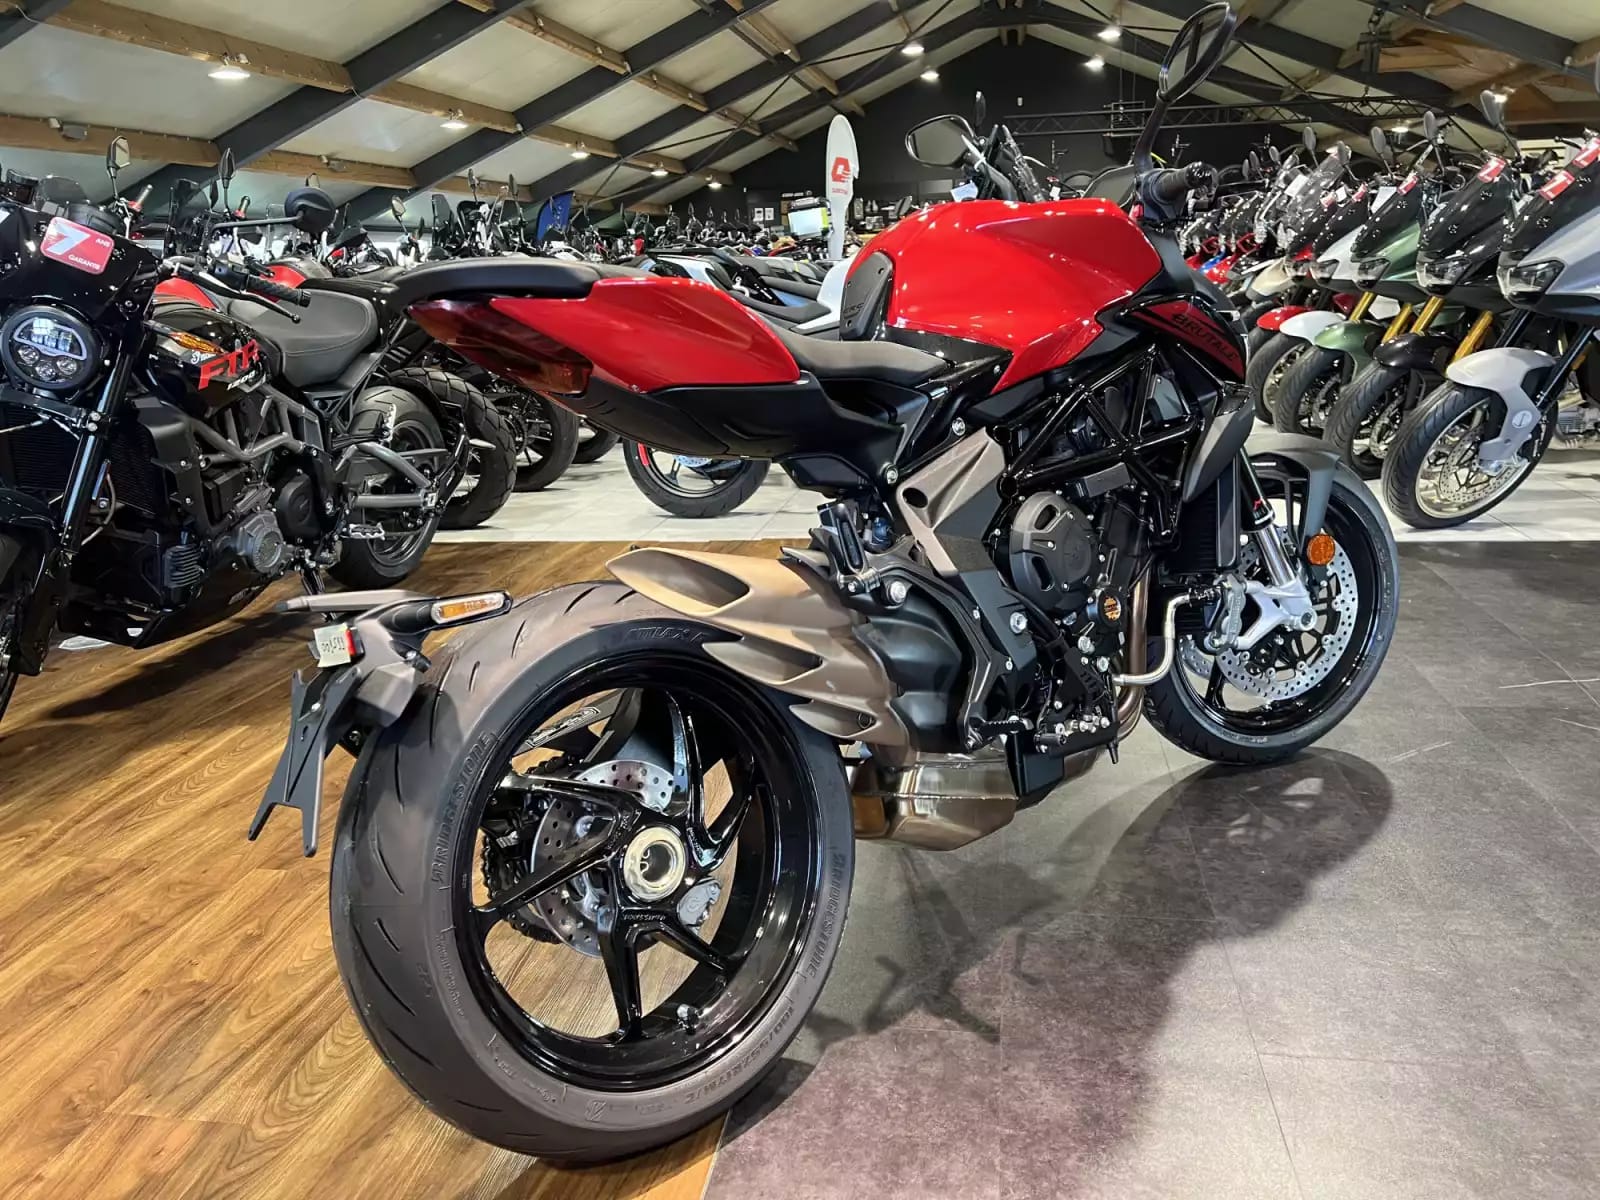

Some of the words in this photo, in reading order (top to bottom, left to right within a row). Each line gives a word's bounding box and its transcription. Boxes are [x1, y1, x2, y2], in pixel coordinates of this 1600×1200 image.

[46, 220, 92, 255] 7
[1171, 312, 1238, 359] BRUTALE
[198, 338, 260, 391] FTR
[431, 731, 498, 886] BRIDGESTONE
[806, 853, 848, 979] BRIDGESTONE
